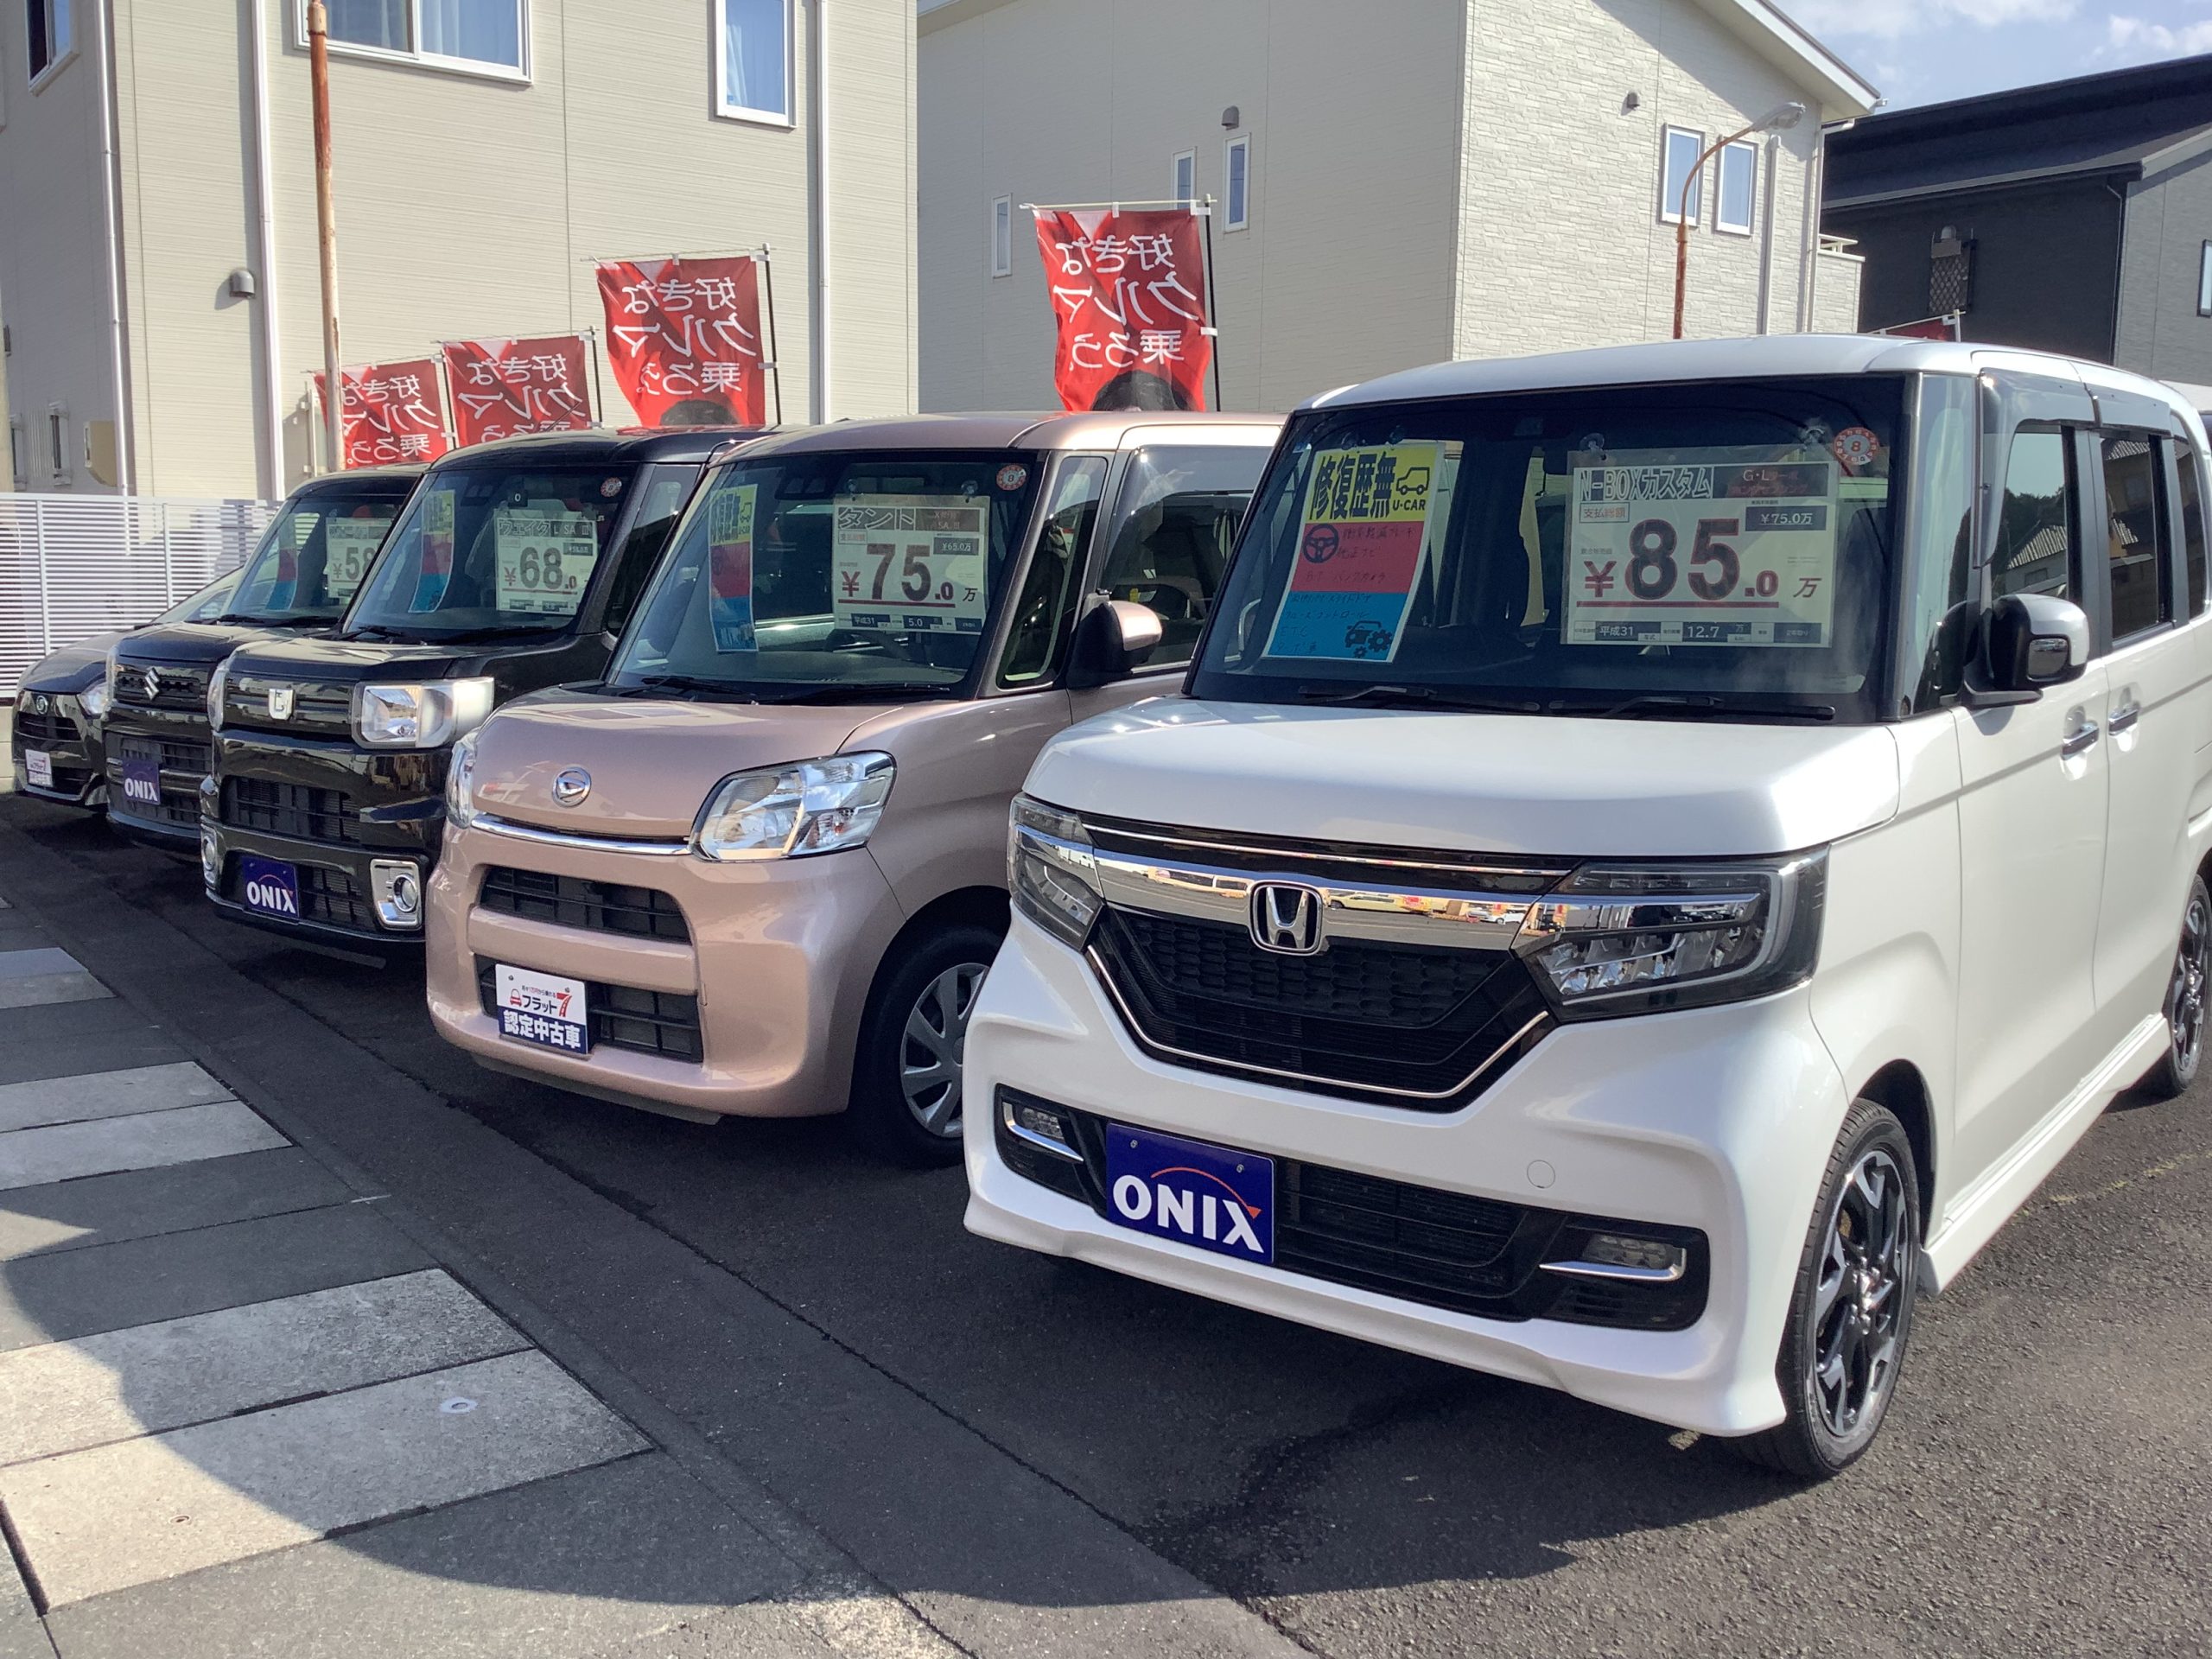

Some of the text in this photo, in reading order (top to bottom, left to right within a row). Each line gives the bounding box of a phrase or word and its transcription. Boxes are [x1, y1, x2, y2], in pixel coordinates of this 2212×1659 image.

[1309, 451, 1397, 520] 修復歴無
[1579, 466, 1713, 501] N-BOXカスタム
[837, 507, 915, 531] タント
[1761, 512, 1813, 524] ¥75.0万
[963, 588, 978, 602] 万
[1792, 576, 1822, 598] 万
[908, 618, 923, 627] 5.0
[1599, 626, 1634, 637] 平成31
[1687, 626, 1720, 639] 12.7
[124, 777, 158, 802] ONIX
[246, 880, 296, 914] ONIX
[503, 1009, 581, 1049] 認定中古車
[1112, 1174, 1265, 1254] ONIX
